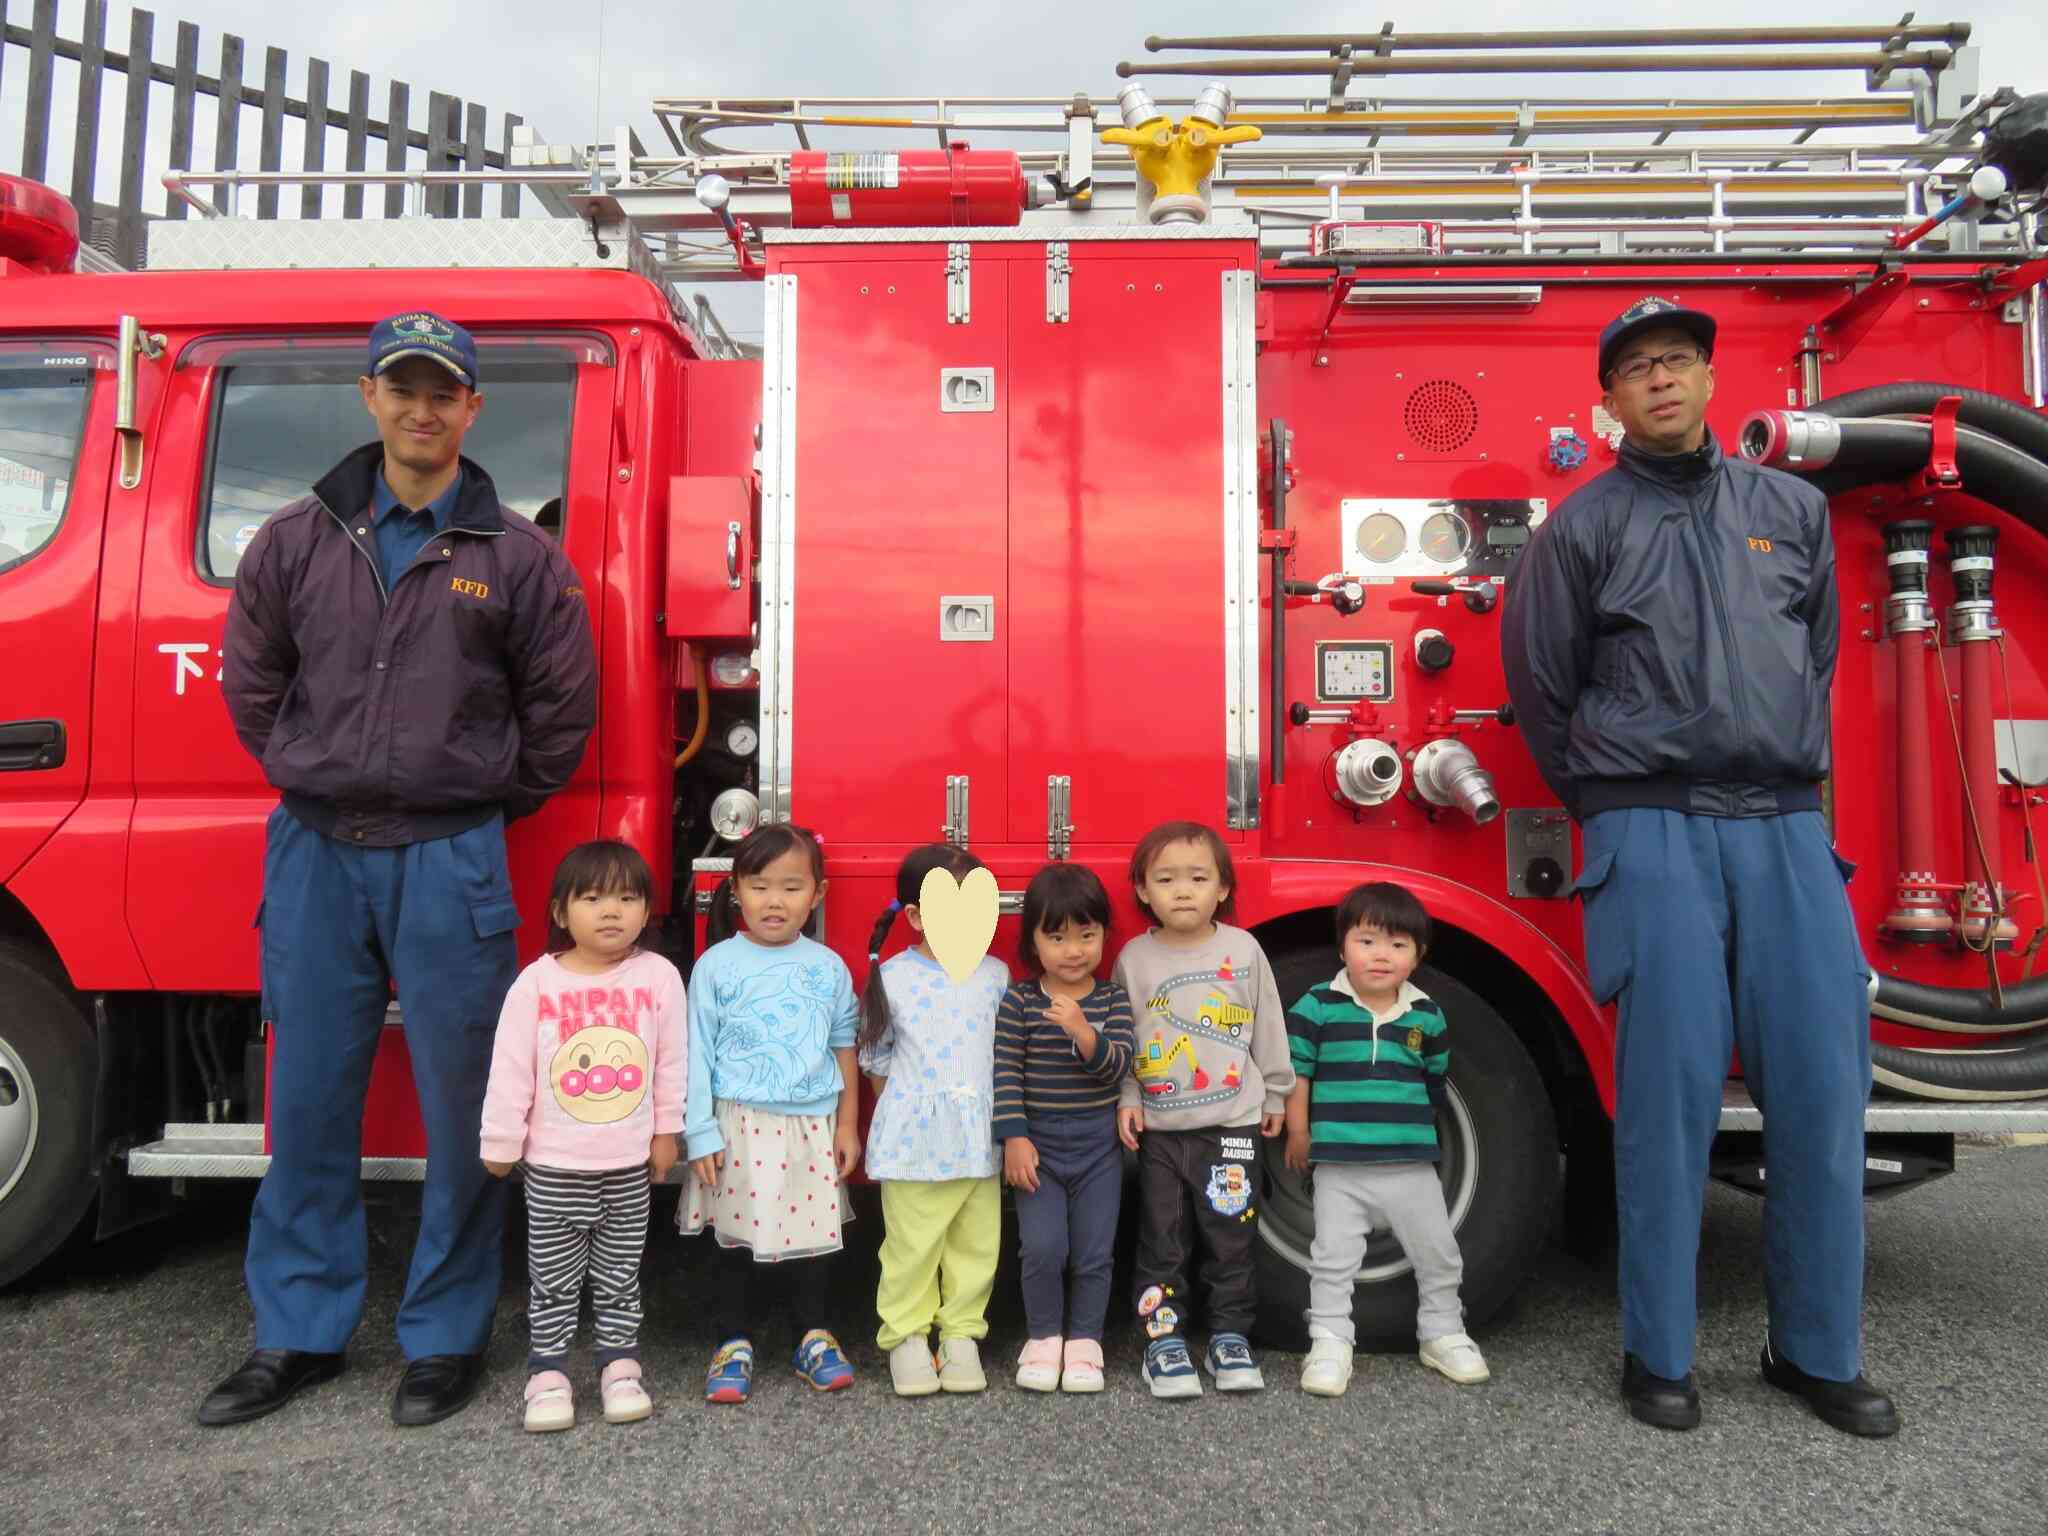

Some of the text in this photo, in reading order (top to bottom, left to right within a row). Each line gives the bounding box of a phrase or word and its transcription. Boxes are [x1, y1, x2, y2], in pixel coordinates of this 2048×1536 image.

[44, 356, 87, 365] HINO
[451, 577, 489, 599] KFD
[158, 643, 224, 695] 下
[538, 988, 653, 1022] ANPAN
[1221, 1137, 1253, 1149] MINNA
[1222, 1148, 1255, 1160] DAISUKI
